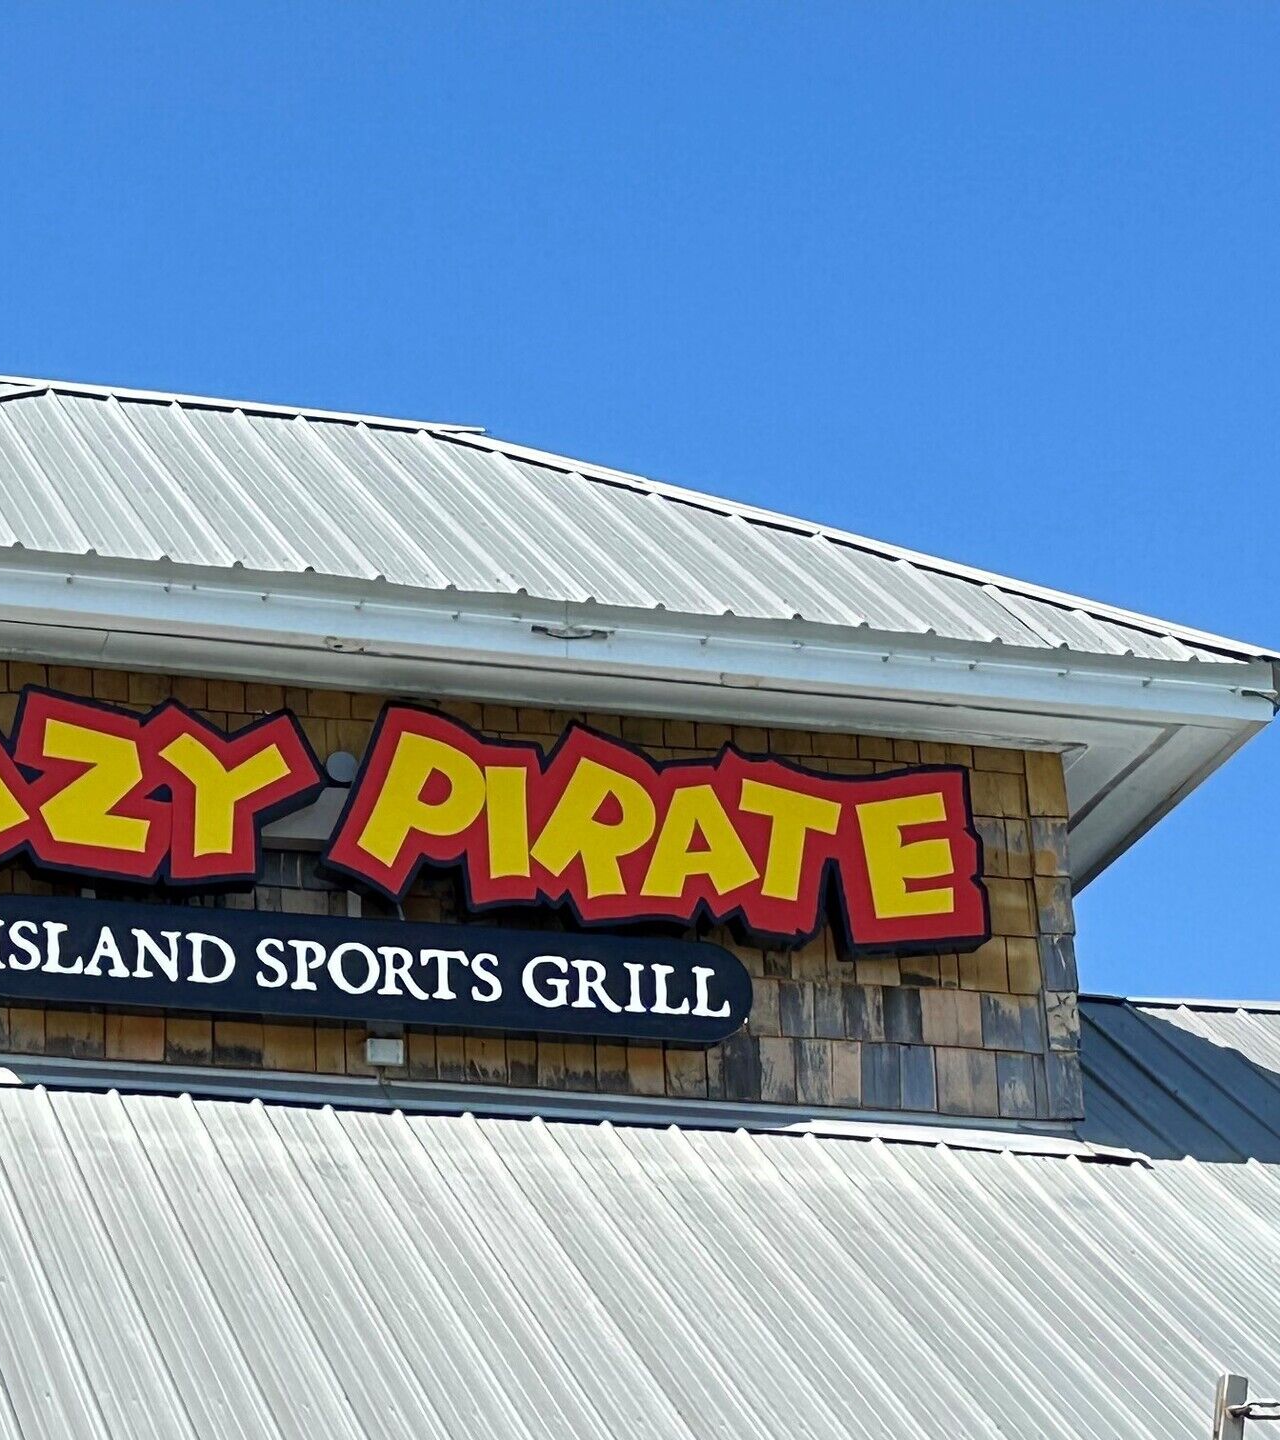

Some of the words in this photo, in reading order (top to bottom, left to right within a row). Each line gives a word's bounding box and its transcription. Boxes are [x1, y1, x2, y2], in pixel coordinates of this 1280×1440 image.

[358, 730, 956, 918] PIRATE
[254, 937, 504, 1003] SPORTS
[520, 954, 732, 1019] GRILL
